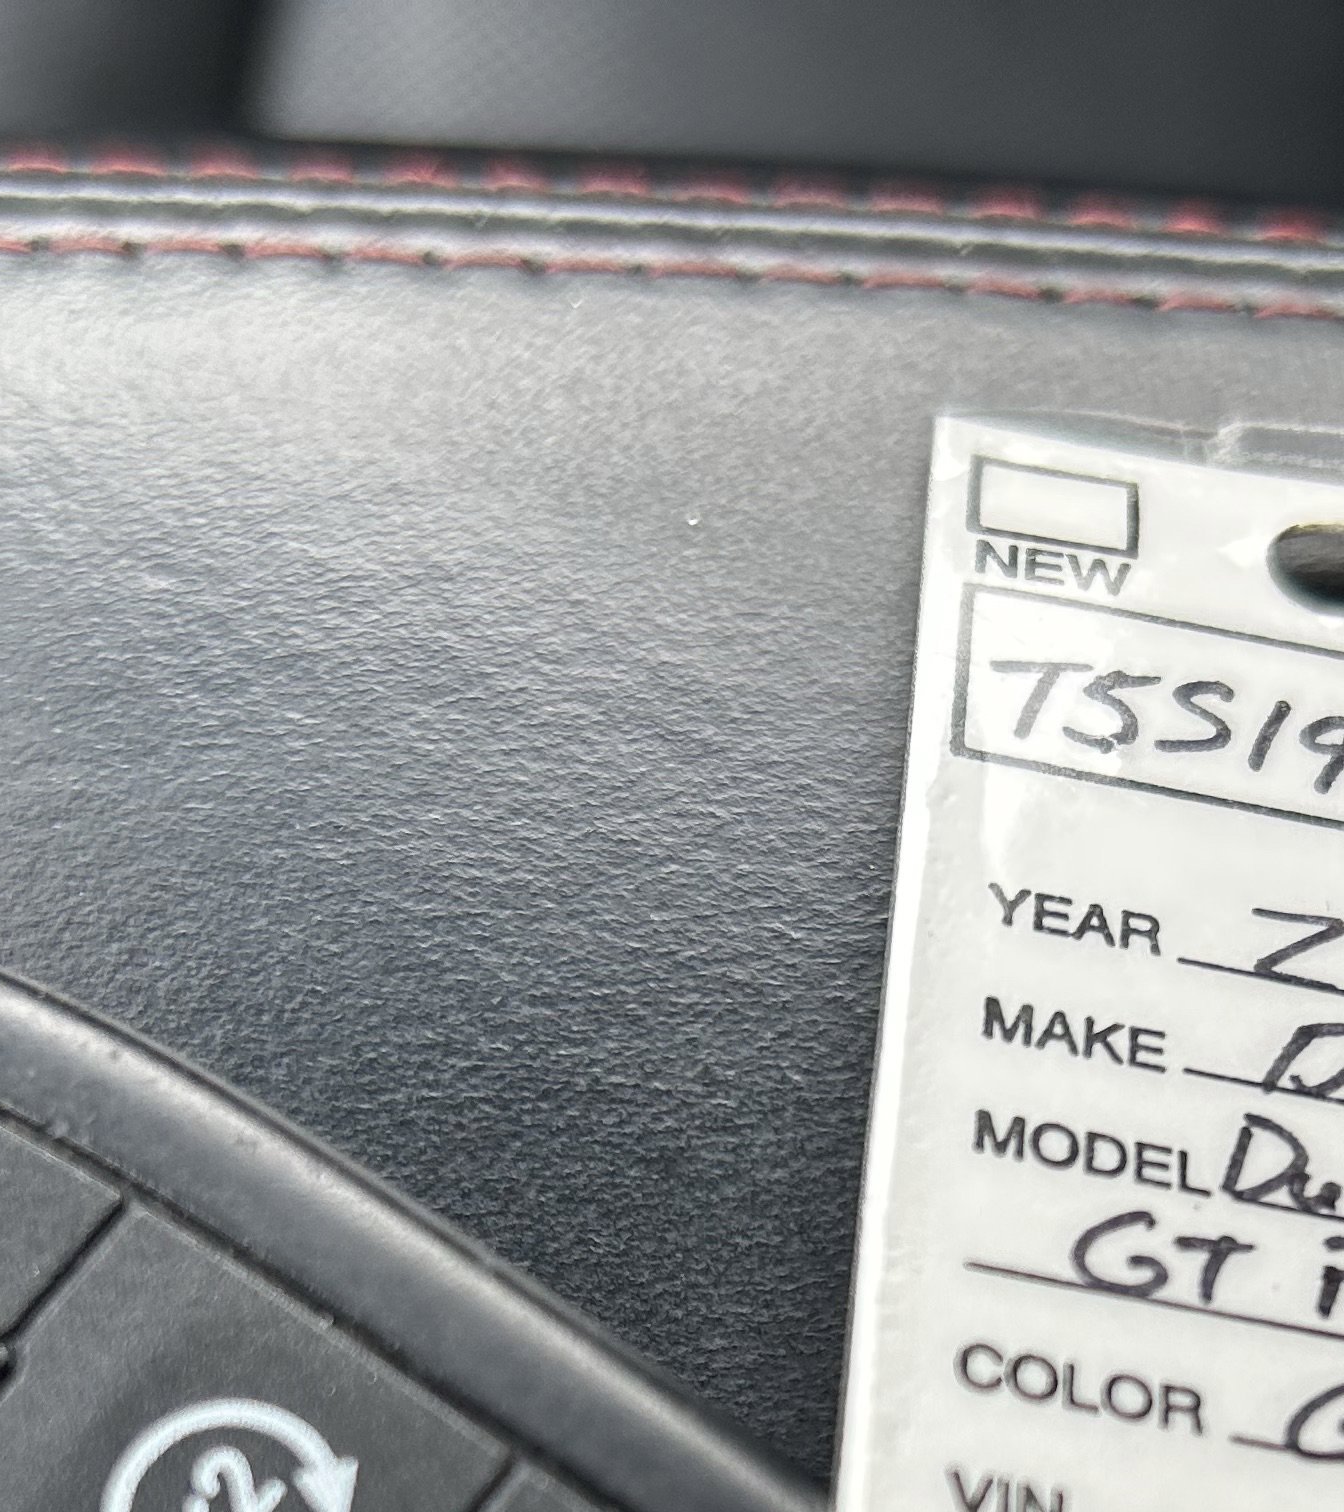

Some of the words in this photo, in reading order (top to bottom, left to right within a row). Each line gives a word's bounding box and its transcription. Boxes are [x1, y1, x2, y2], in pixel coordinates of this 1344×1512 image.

[974, 538, 1131, 595] NEW
[989, 883, 1162, 957] YEAR
[982, 995, 1166, 1073] MAKE
[972, 1110, 1211, 1197] MODEL
[1071, 1210, 1254, 1304] GT
[954, 1343, 1204, 1436] COLOR
